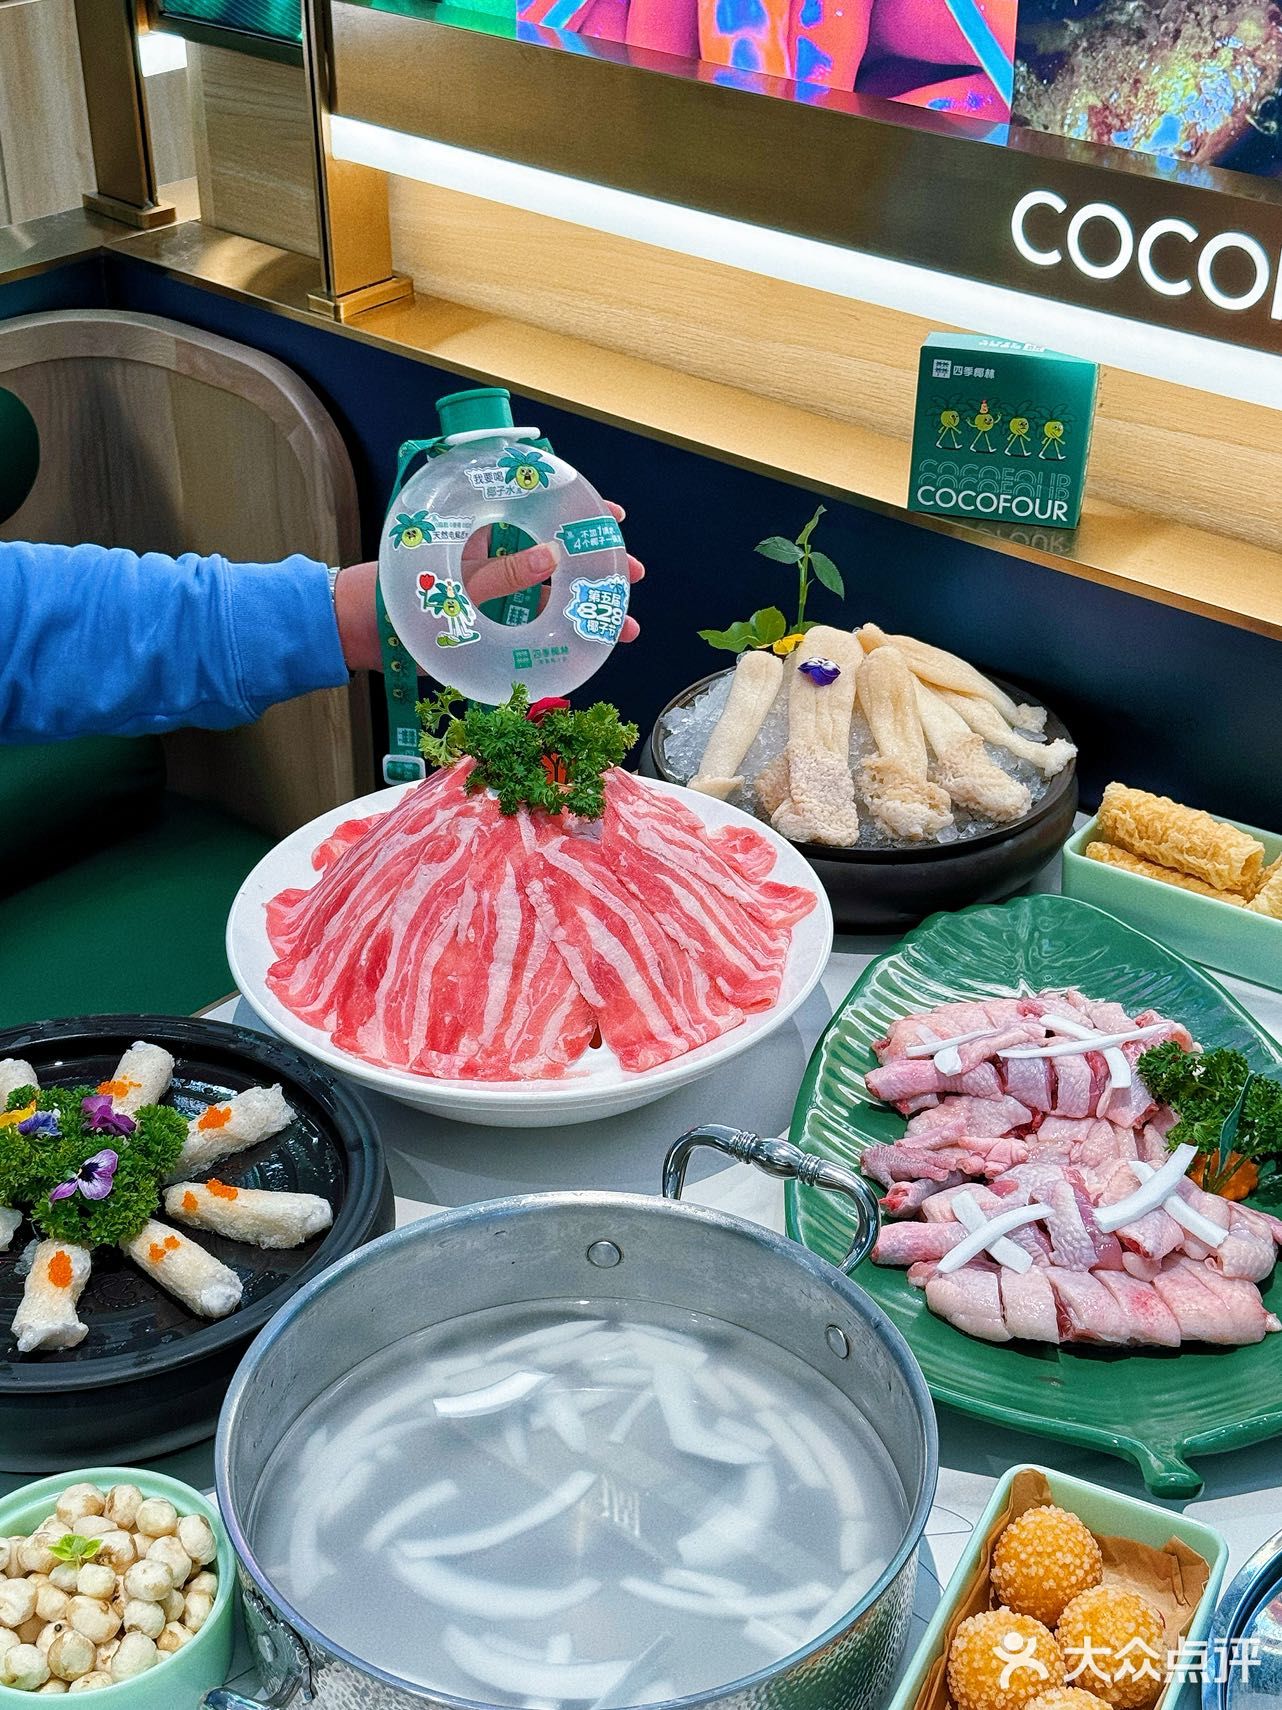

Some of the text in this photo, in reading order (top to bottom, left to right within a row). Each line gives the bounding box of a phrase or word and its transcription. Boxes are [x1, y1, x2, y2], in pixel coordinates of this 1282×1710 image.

[1011, 190, 1282, 320] COCO
[953, 365, 995, 379] 四季椰林
[474, 471, 504, 484] 我要喝
[487, 484, 515, 497] 椰子水
[917, 485, 1068, 522] COCOFOUR
[588, 589, 622, 608] 第五届
[577, 602, 623, 626] 828
[587, 619, 617, 637] 椰子节
